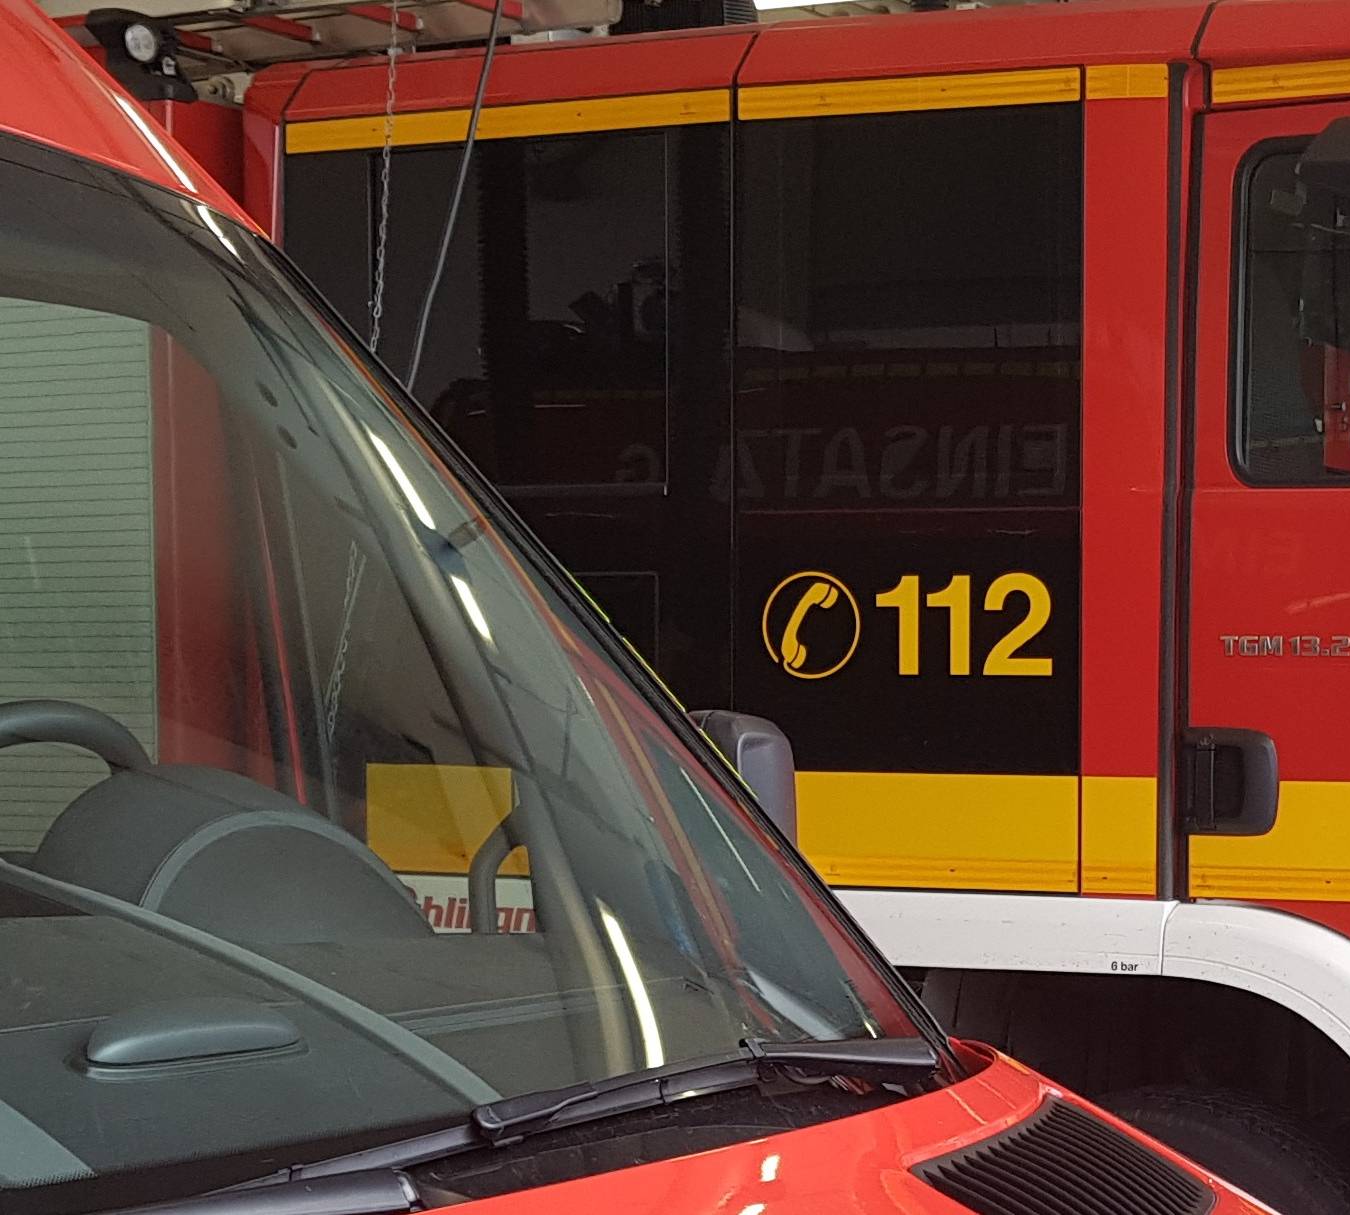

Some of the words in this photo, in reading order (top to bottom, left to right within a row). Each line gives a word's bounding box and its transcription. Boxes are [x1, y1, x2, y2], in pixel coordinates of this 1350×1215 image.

[876, 572, 1053, 676] 112
[1220, 635, 1283, 656] TGM
[1111, 961, 1118, 971] 6
[1120, 961, 1138, 972] bar
